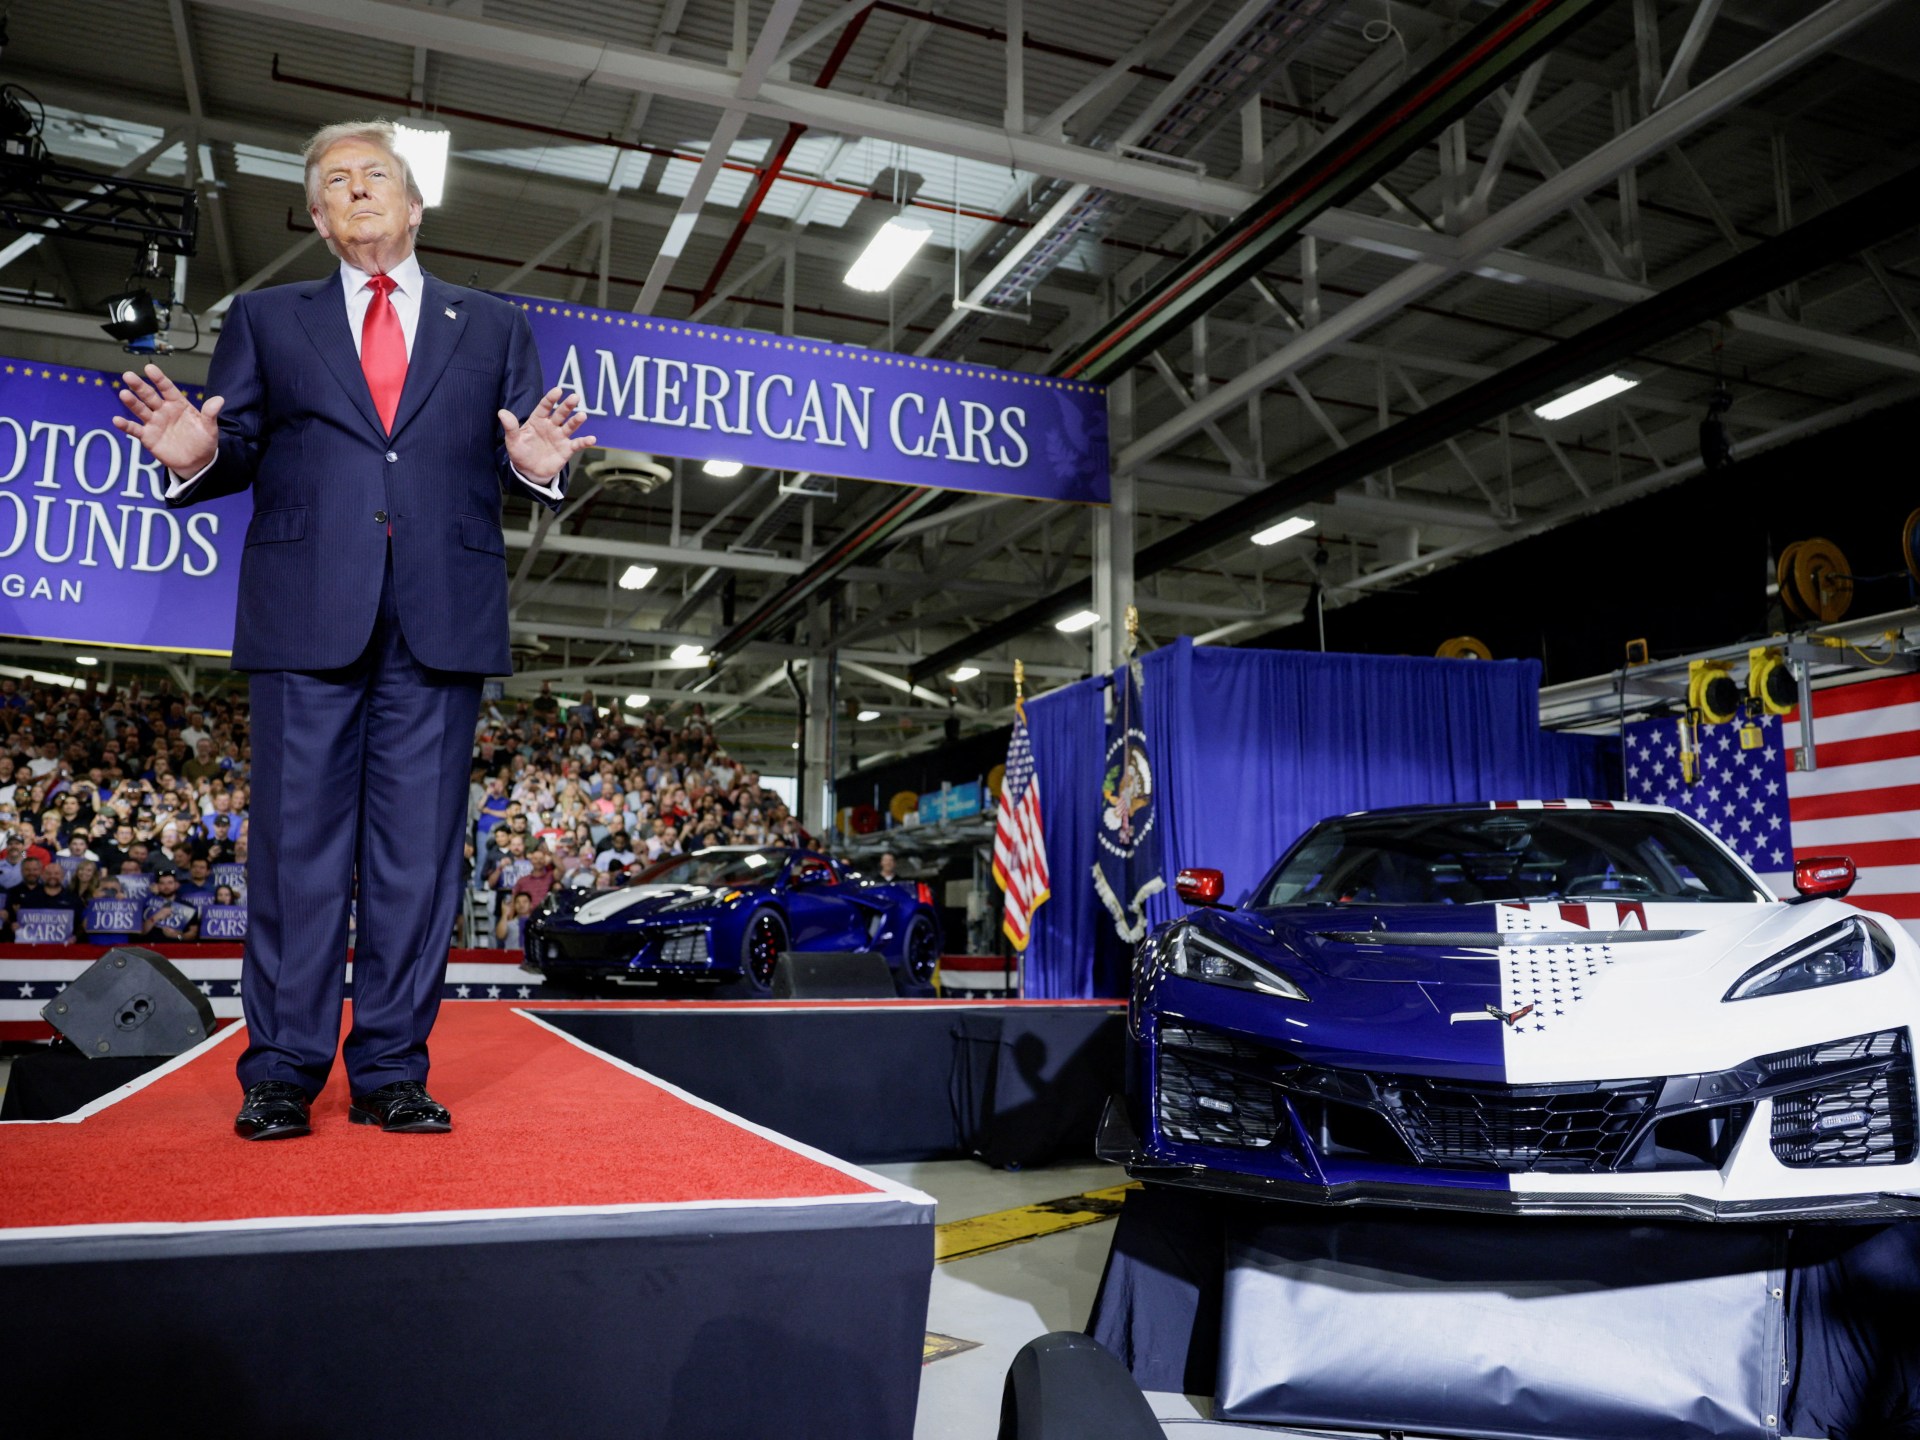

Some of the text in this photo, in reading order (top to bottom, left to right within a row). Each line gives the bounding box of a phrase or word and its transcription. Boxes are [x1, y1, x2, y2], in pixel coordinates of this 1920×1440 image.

[554, 345, 1028, 468] AMERICAN CARS
[2, 574, 82, 602] GAN
[92, 902, 138, 912] AMERICAN
[206, 909, 247, 918] AMERICAN
[21, 913, 69, 924] AMERICAN
[94, 911, 134, 929] JOBS
[207, 918, 247, 936] CARS
[22, 923, 66, 941] CARS
